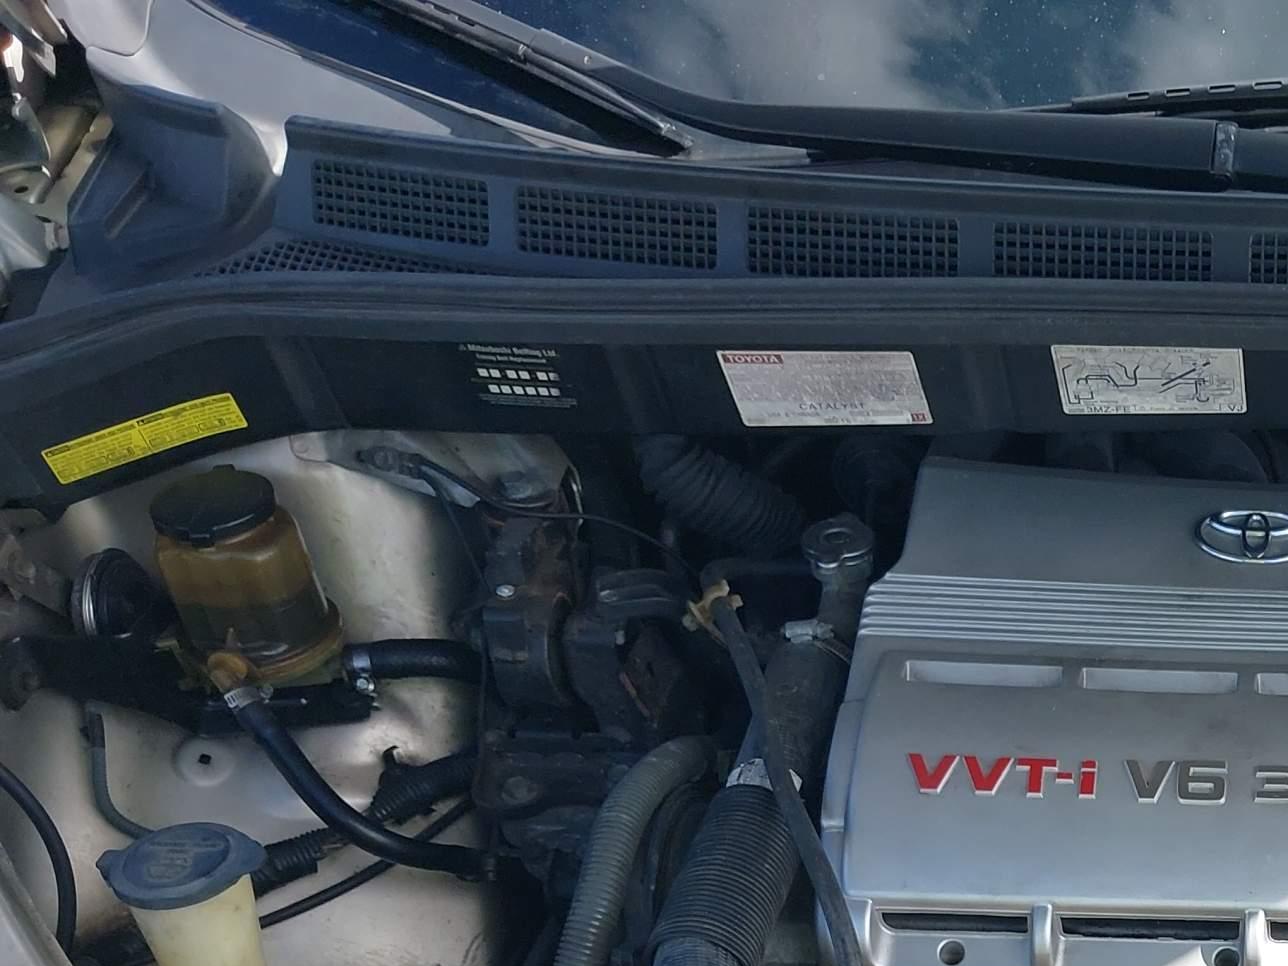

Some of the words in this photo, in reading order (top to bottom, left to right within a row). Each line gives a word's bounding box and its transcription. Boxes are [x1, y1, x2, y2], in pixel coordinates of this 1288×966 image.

[727, 355, 780, 364] TOYOTA
[799, 403, 865, 411] CATALYST
[908, 753, 1099, 799] VVT-i
[1125, 759, 1229, 804] V6
